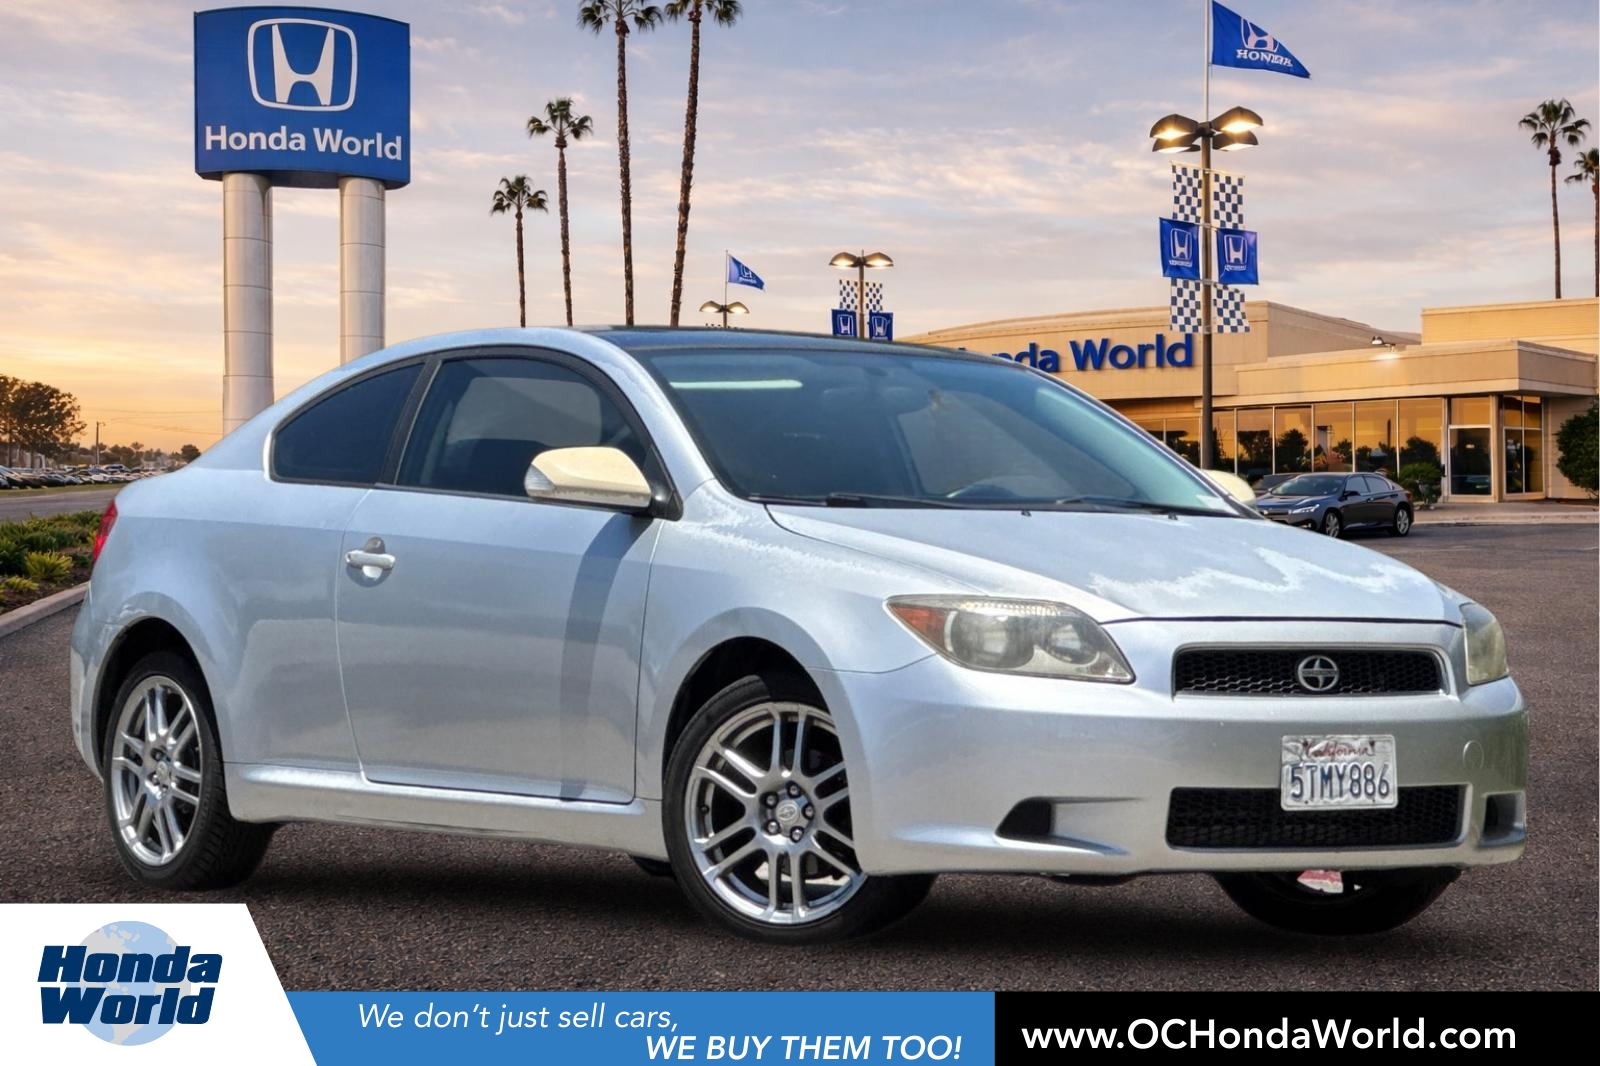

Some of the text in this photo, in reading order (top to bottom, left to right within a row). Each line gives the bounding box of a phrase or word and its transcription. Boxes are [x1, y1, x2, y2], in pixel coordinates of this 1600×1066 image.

[205, 125, 402, 161] Honda World
[1069, 333, 1194, 371] World
[1290, 763, 1390, 801] 5TMY886
